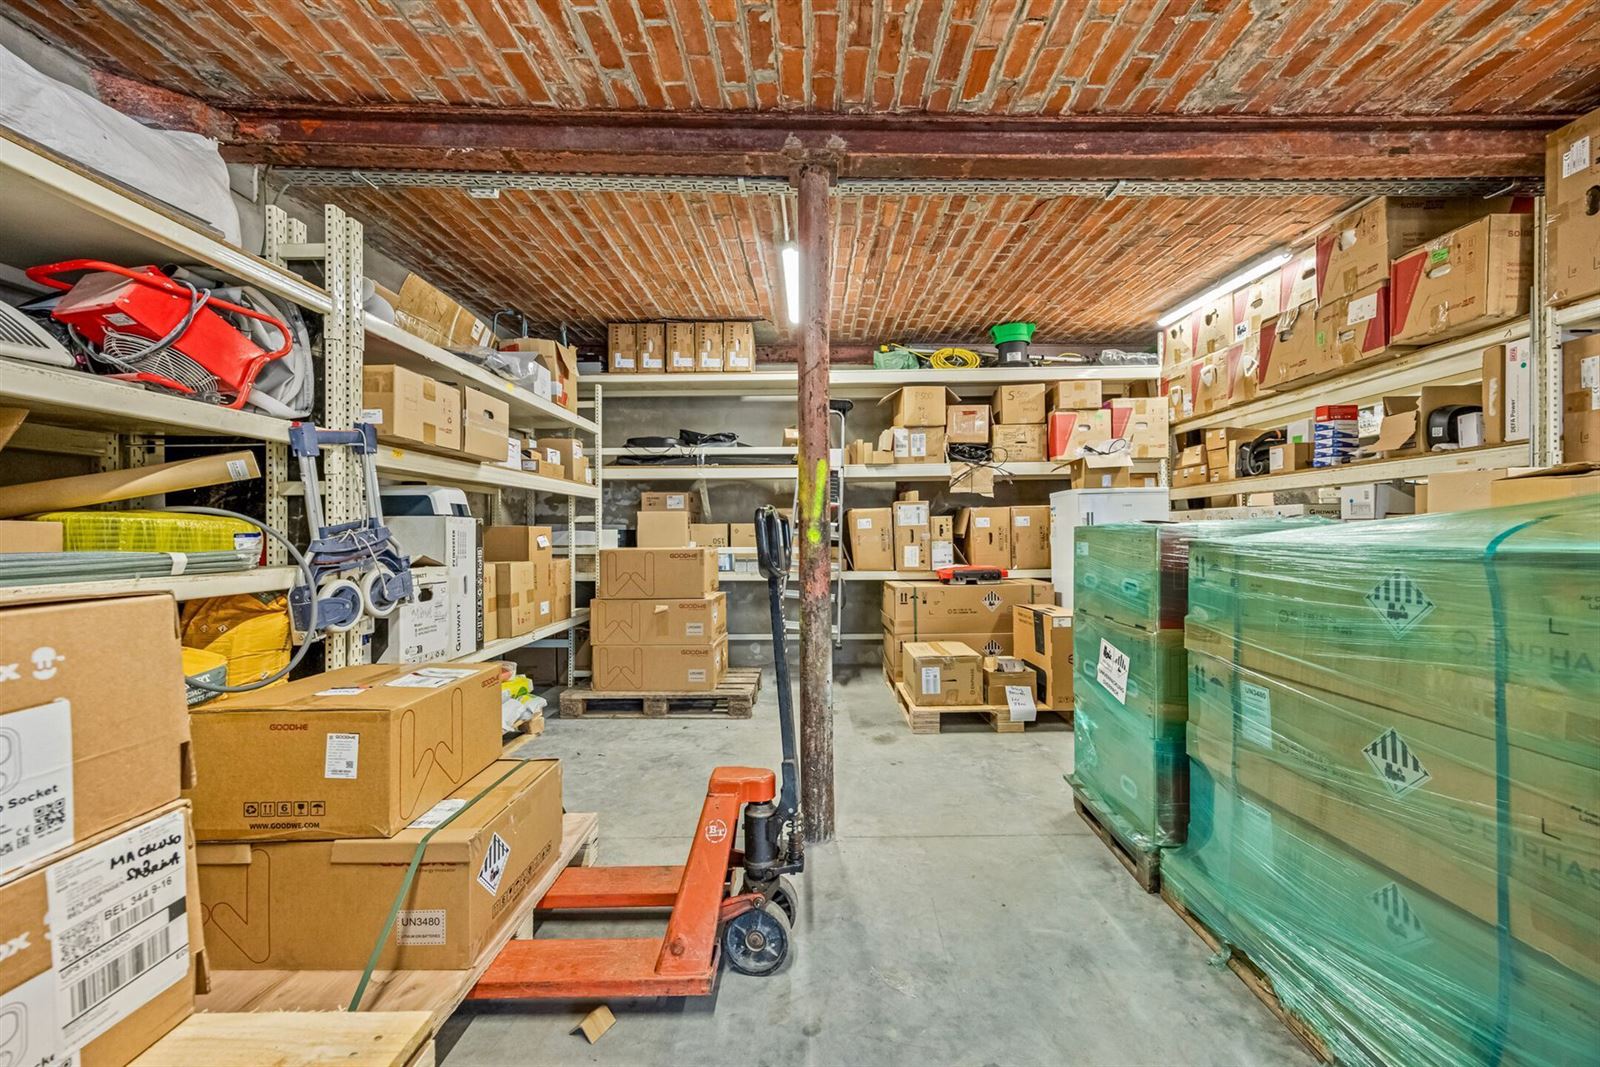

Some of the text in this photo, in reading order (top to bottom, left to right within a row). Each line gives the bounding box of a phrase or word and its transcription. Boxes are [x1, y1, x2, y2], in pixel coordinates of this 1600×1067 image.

[269, 723, 309, 731] GOODWE
[8, 784, 57, 809] Socket
[249, 822, 320, 830] WWW.GOODWE.COM
[104, 900, 128, 920] BEL
[401, 917, 440, 927] UN3480
